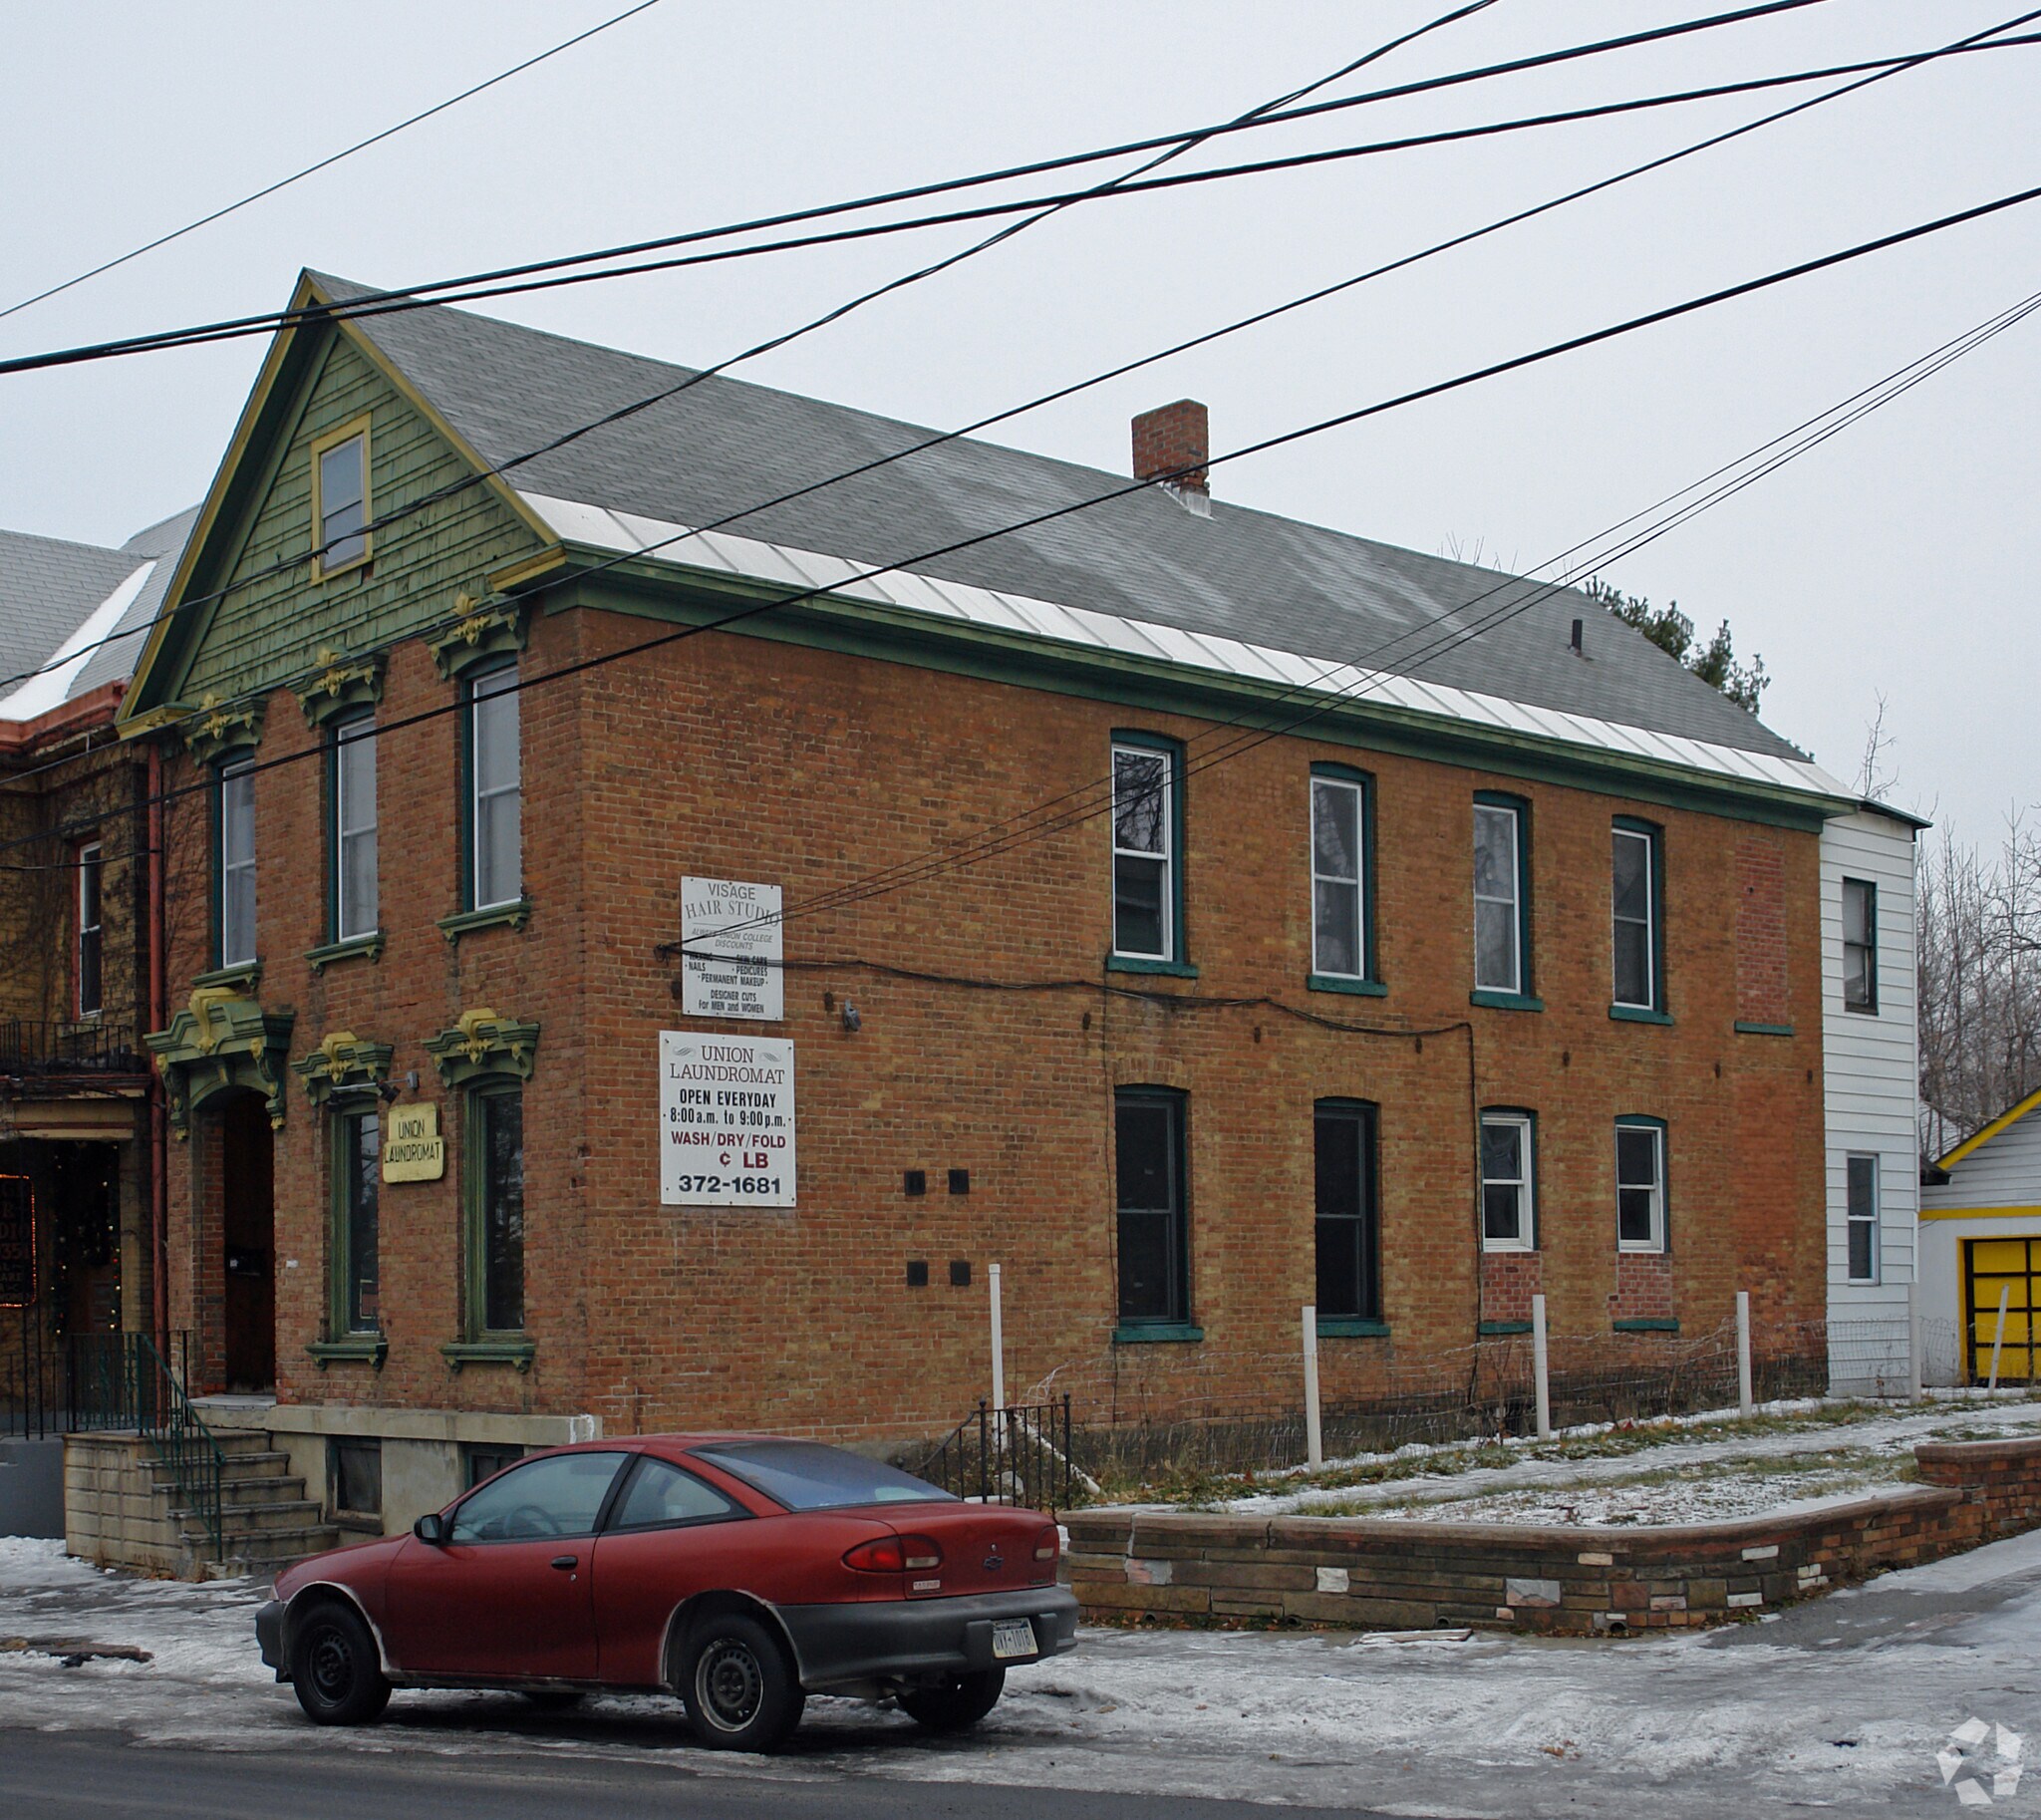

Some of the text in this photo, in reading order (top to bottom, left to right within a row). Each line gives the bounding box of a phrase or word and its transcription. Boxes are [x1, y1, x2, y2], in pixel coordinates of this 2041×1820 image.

[709, 883, 755, 900] VISAGE
[686, 900, 779, 927] HAIR STUDIO
[715, 940, 753, 950] DISCOUNTS
[742, 933, 773, 943] COLLEGE
[689, 962, 706, 972] NAILS
[736, 966, 767, 976] PEDICURES
[702, 973, 765, 987] PERMANENT MAKEUP
[711, 990, 756, 1002] DESIGNER CUTS
[712, 1000, 725, 1011] MEN
[728, 1002, 738, 1012] and
[741, 1003, 764, 1014] WOMEN
[701, 1045, 754, 1063] UNION
[670, 1063, 785, 1084] LAUNDROMAT
[680, 1088, 776, 1108] OPEN EVERYDAY
[724, 1109, 734, 1124] to
[398, 1118, 426, 1139] UNION
[385, 1141, 440, 1164] LAUNDROMAT
[742, 1152, 769, 1169] LB
[679, 1175, 780, 1194] 372-1681
